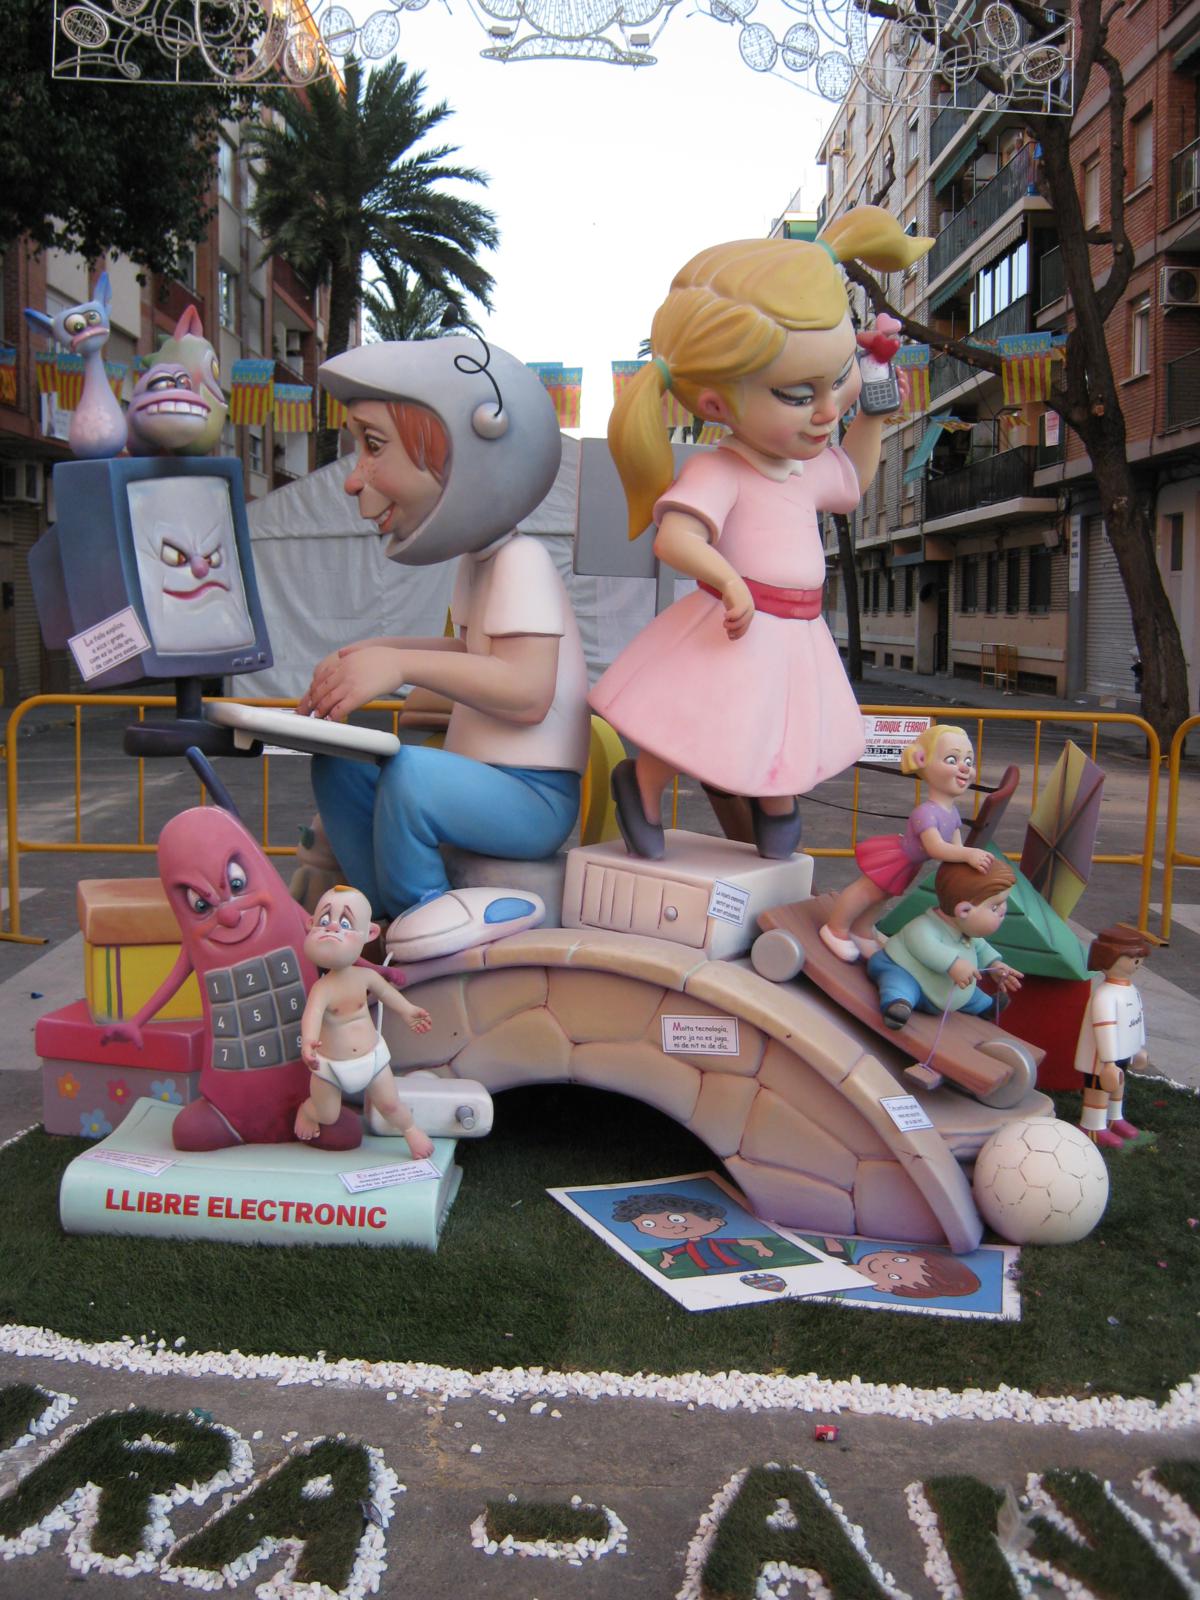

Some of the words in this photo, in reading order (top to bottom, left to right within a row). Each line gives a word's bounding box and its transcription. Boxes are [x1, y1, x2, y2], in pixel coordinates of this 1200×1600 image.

[213, 982, 219, 994] 1
[246, 973, 255, 986] 2
[281, 962, 289, 974] 3
[218, 1016, 225, 1029] 4
[253, 1009, 261, 1021] 5
[290, 998, 297, 1010] 6
[222, 1049, 228, 1061] 7
[259, 1045, 266, 1057] 8
[105, 1188, 200, 1216] LLIBRE
[207, 1196, 388, 1229] ELECTRONIC
